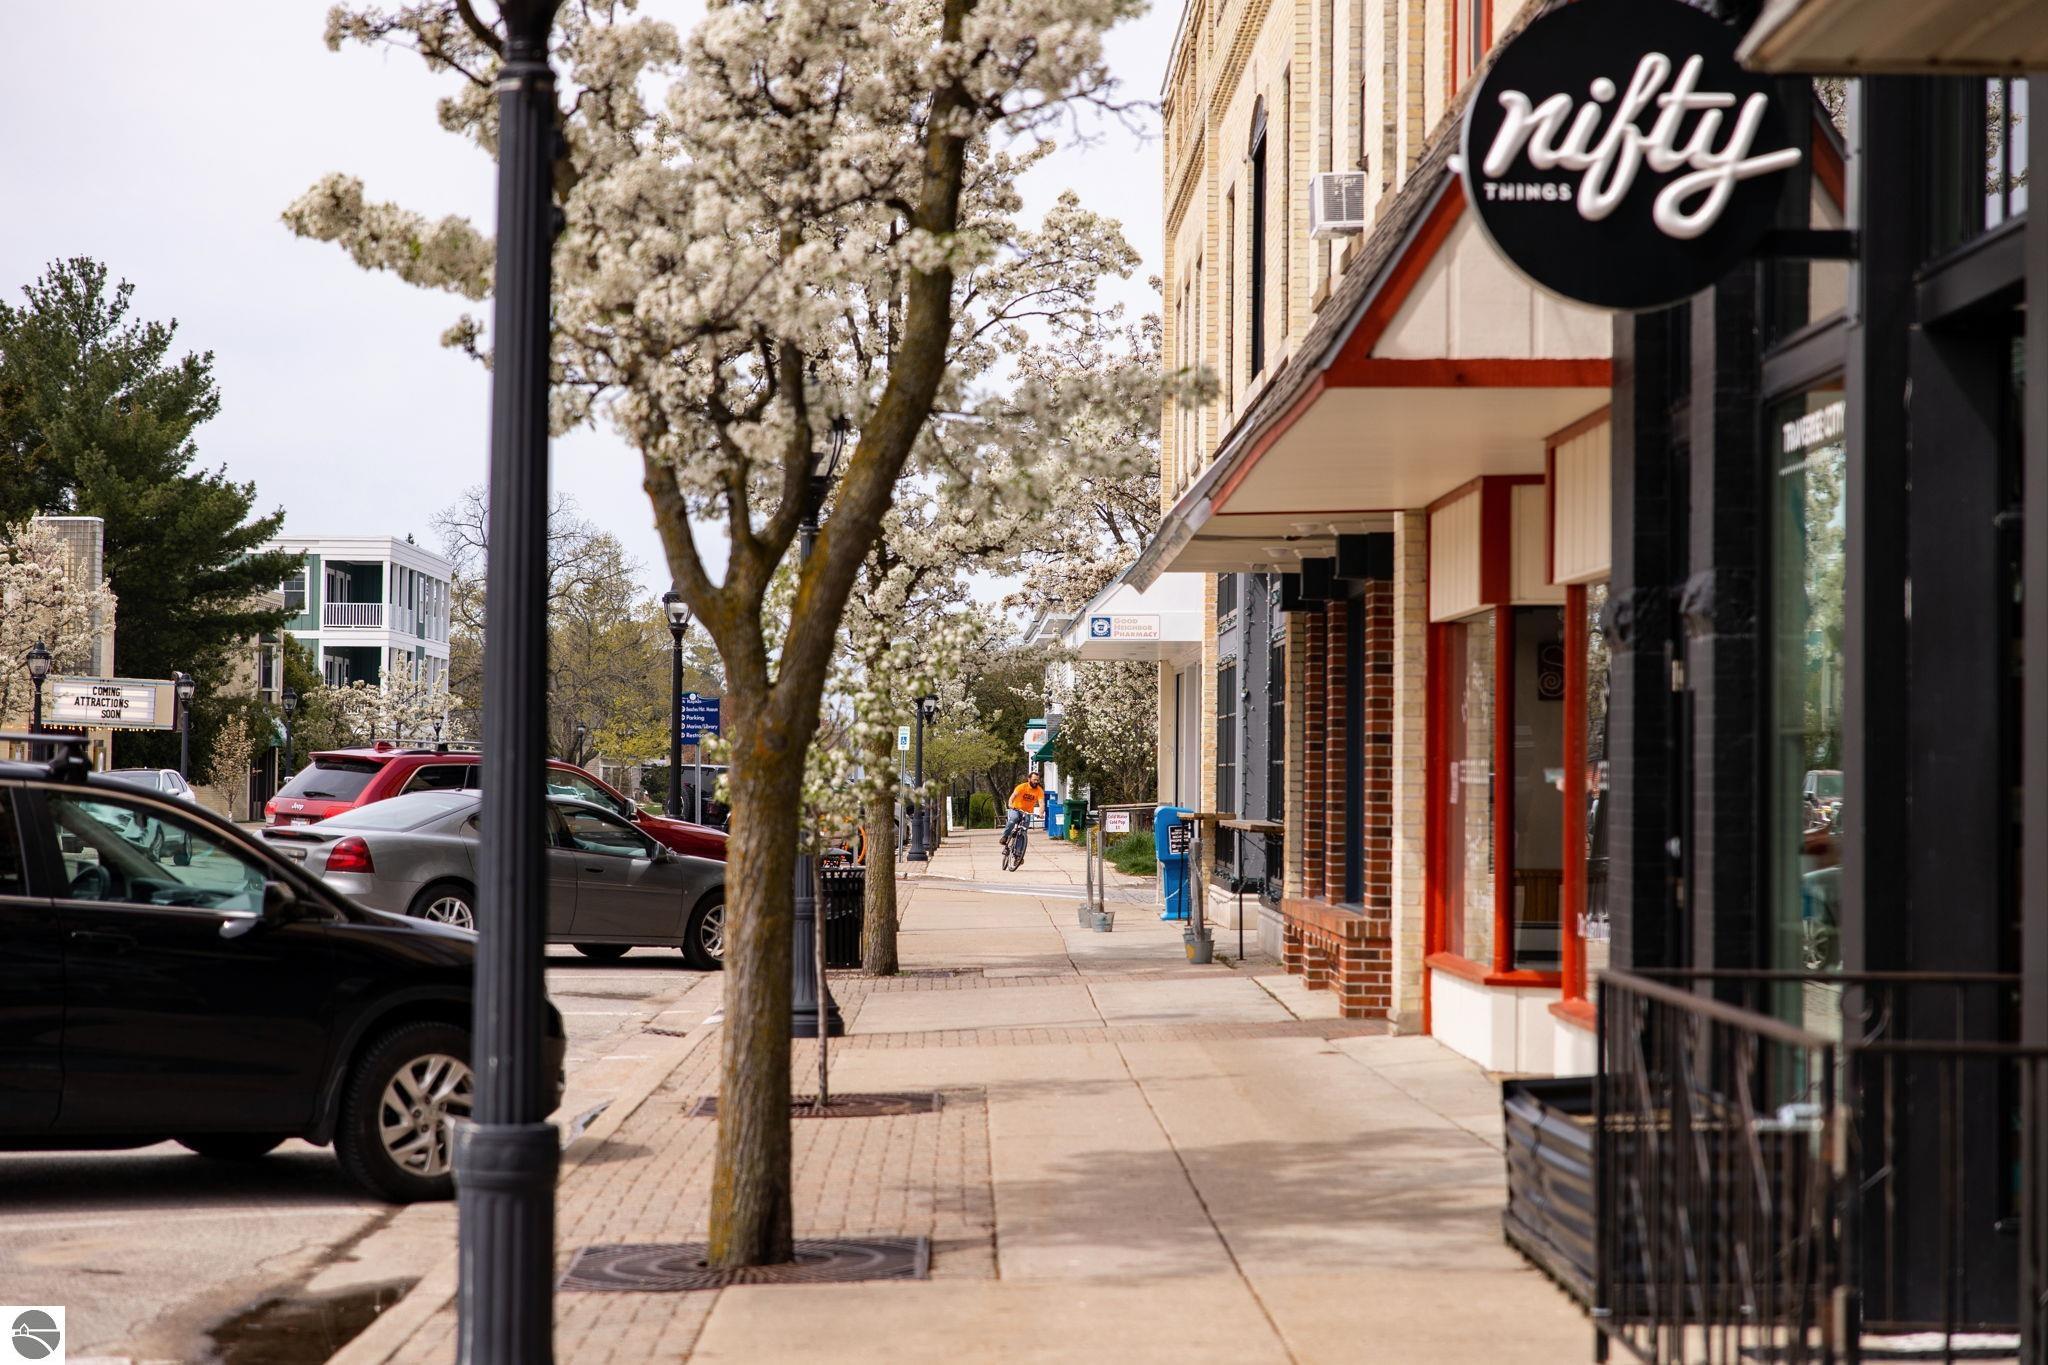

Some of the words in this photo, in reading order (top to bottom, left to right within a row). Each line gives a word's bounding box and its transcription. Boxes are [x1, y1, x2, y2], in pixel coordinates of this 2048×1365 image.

[1483, 52, 1802, 239] nifty
[1483, 182, 1573, 201] THINGS
[92, 686, 121, 697] COMING
[74, 697, 129, 708] ATTRACTIONS
[101, 710, 121, 719] SOON
[291, 802, 304, 811] Jeep
